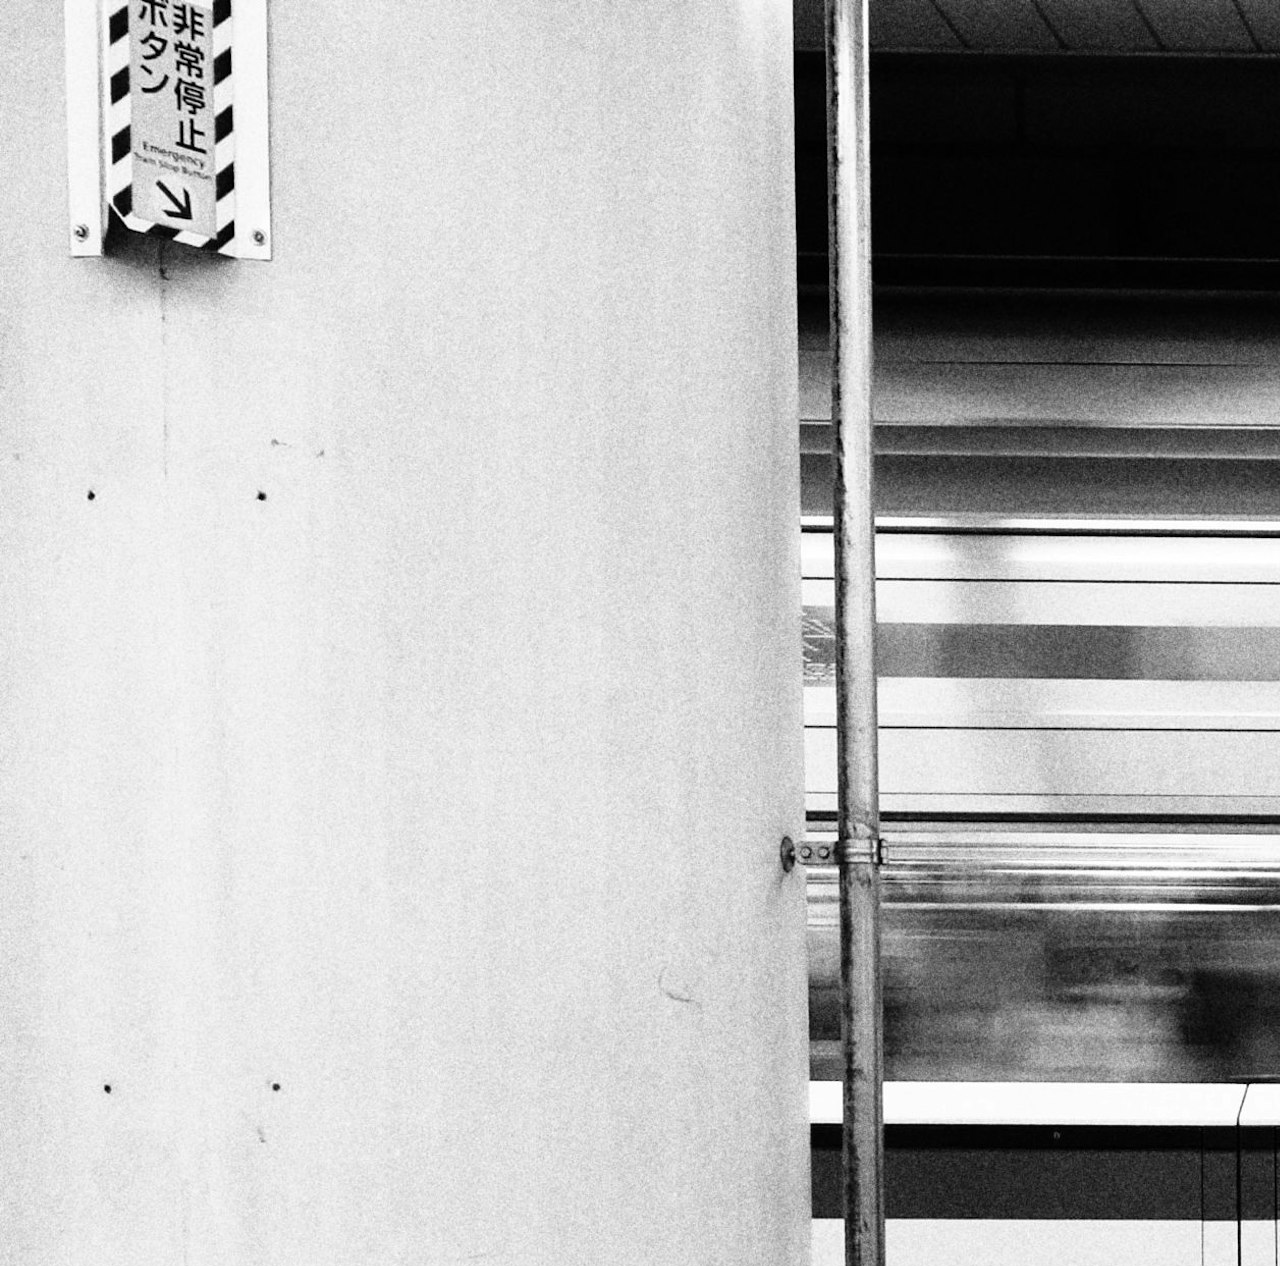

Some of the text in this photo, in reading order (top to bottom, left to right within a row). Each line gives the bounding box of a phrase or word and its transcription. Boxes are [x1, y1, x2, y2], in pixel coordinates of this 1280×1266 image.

[138, 0, 169, 93] ボタン
[172, 3, 207, 154] 非常停止
[142, 141, 205, 170] Emergency
